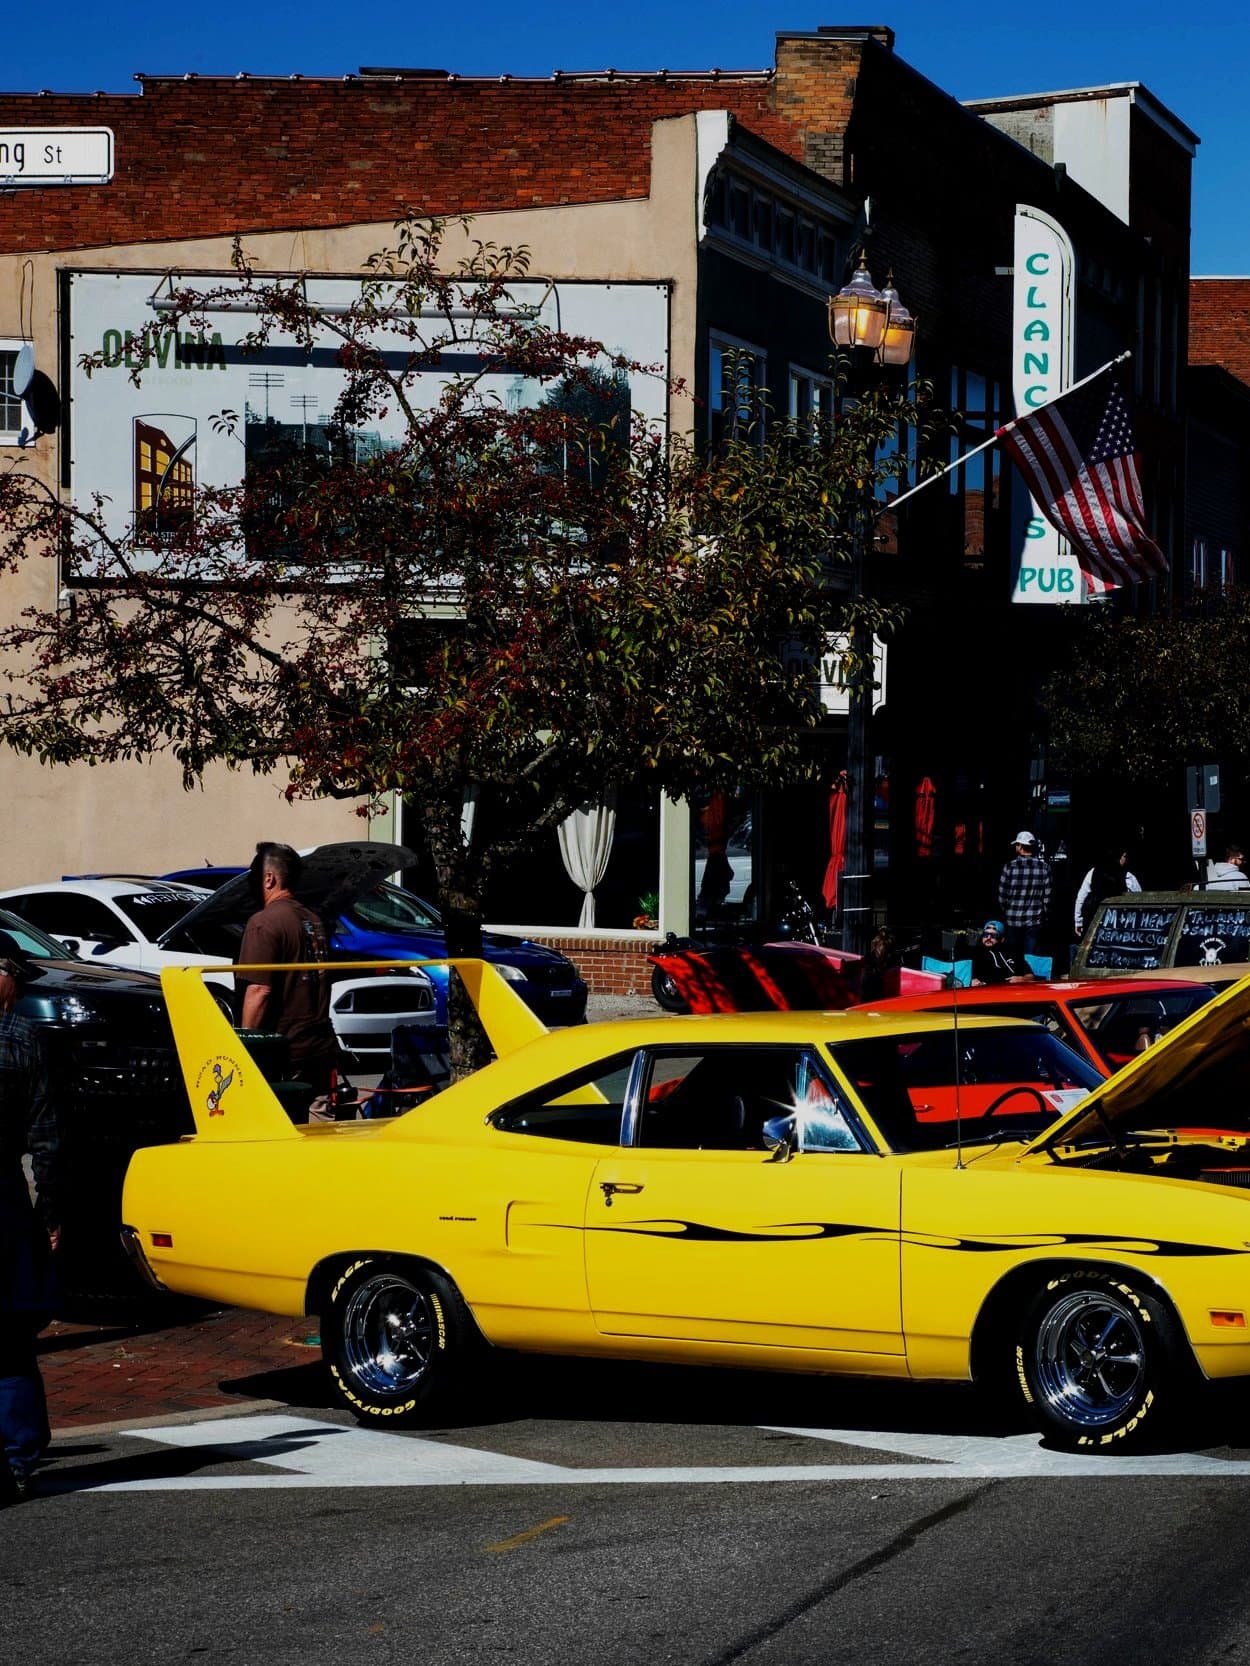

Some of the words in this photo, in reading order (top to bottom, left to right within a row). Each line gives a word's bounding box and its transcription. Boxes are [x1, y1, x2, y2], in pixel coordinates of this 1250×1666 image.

[44, 145, 62, 164] St
[103, 329, 227, 371] OLIVINA
[1019, 567, 1076, 593] PUB
[1046, 1269, 1152, 1323] GOODYEAR
[436, 1313, 446, 1350] NASCAR
[330, 1363, 417, 1417] GOODYEAR
[1099, 1389, 1155, 1446] EAGLE
